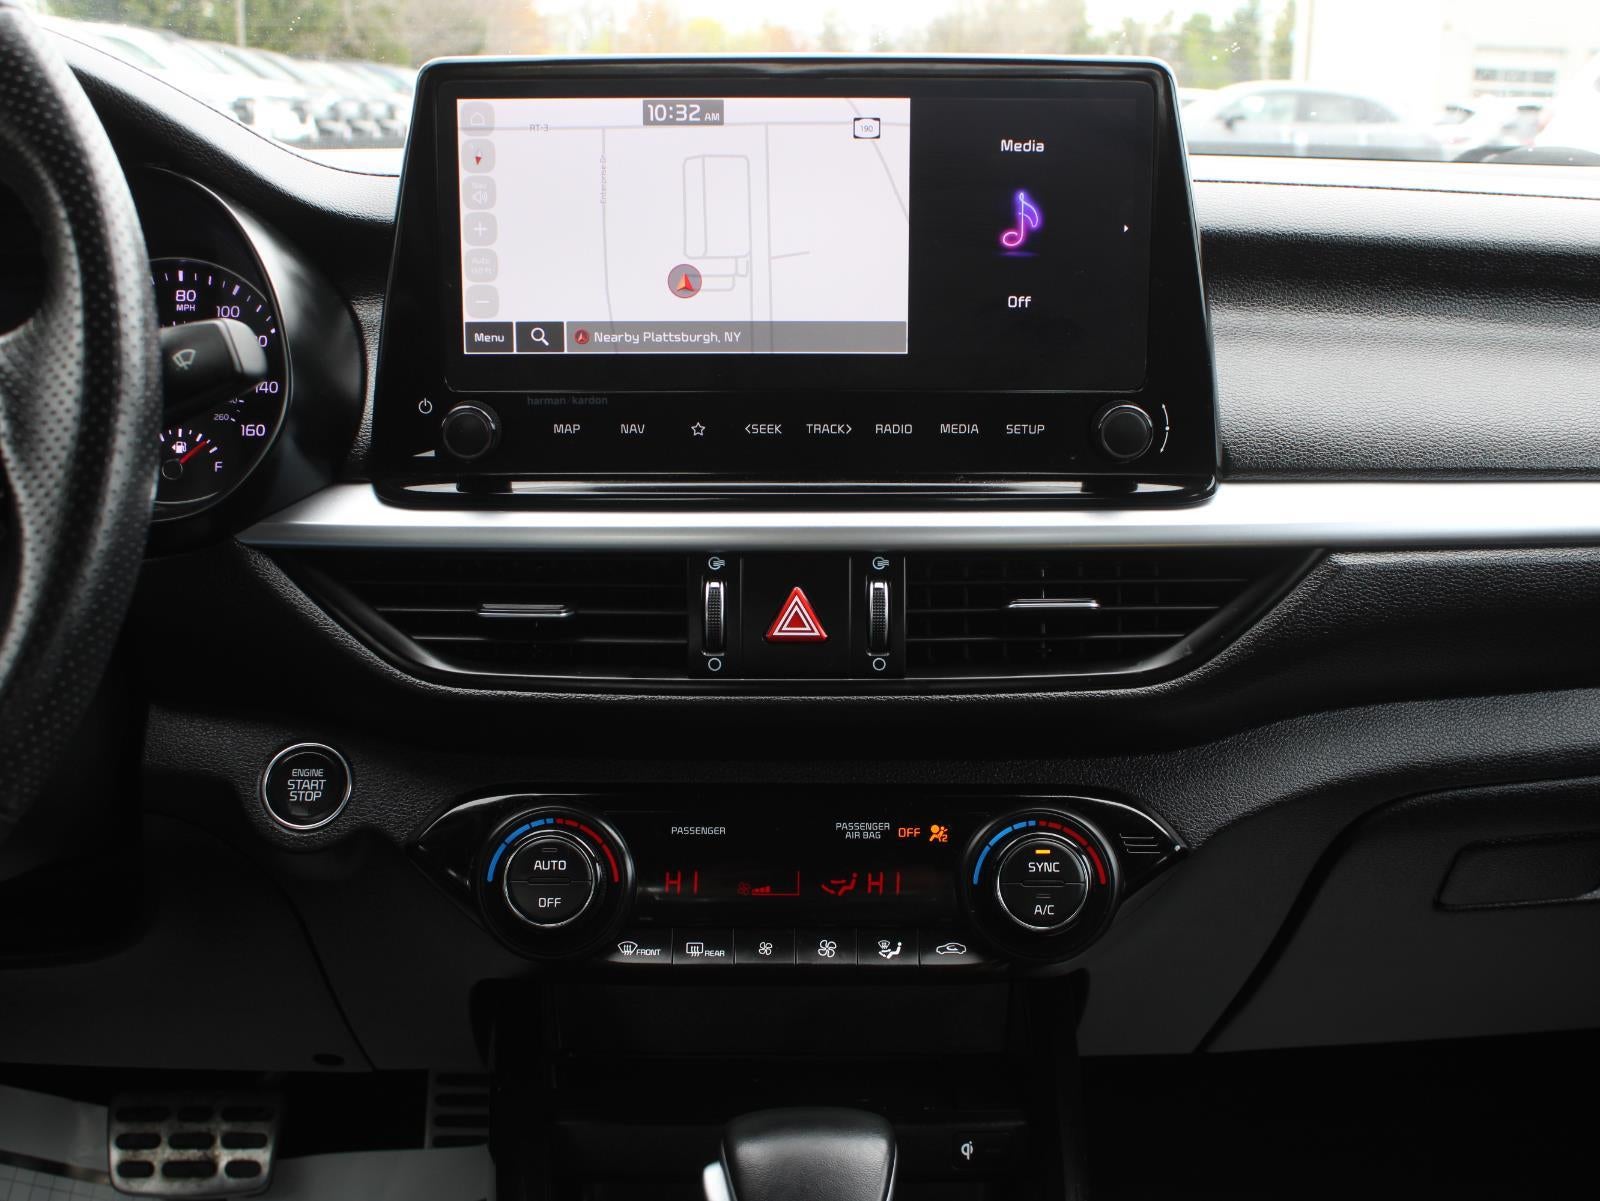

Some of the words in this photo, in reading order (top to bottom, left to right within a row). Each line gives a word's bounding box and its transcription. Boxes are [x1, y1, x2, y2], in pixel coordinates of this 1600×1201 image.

[647, 103, 701, 122] 10:32
[704, 112, 720, 121] AM
[529, 123, 549, 133] RT-3
[860, 125, 873, 133] 190
[1000, 139, 1045, 153] Media
[175, 289, 197, 303] 80
[1007, 295, 1032, 308] Off
[176, 303, 196, 312] MPH
[216, 305, 240, 318] 100
[474, 332, 505, 343] Menu
[594, 332, 640, 344] Nearby
[643, 331, 721, 344] Plattsburgh,
[724, 331, 741, 342] NY
[241, 424, 266, 437] 160
[553, 423, 581, 434] MAP
[620, 423, 645, 434] NAV
[875, 423, 913, 434] RADIO
[940, 423, 979, 434] MEDIA
[1006, 423, 1045, 435] SETUP
[214, 461, 223, 472] F
[291, 768, 324, 777] ENGINE
[287, 779, 326, 790] START
[289, 790, 322, 802] STOP
[671, 826, 726, 835] PASSENGER
[835, 822, 890, 832] PASSENGER
[898, 827, 921, 838] OFF
[845, 831, 860, 839] AIR
[861, 831, 881, 839] BAG
[534, 860, 567, 871] AUTO
[1028, 861, 1060, 873] SYNC
[538, 897, 562, 908] OFF
[1034, 904, 1056, 916] A/C
[636, 948, 661, 956] FRONT
[704, 949, 725, 957] REAR
